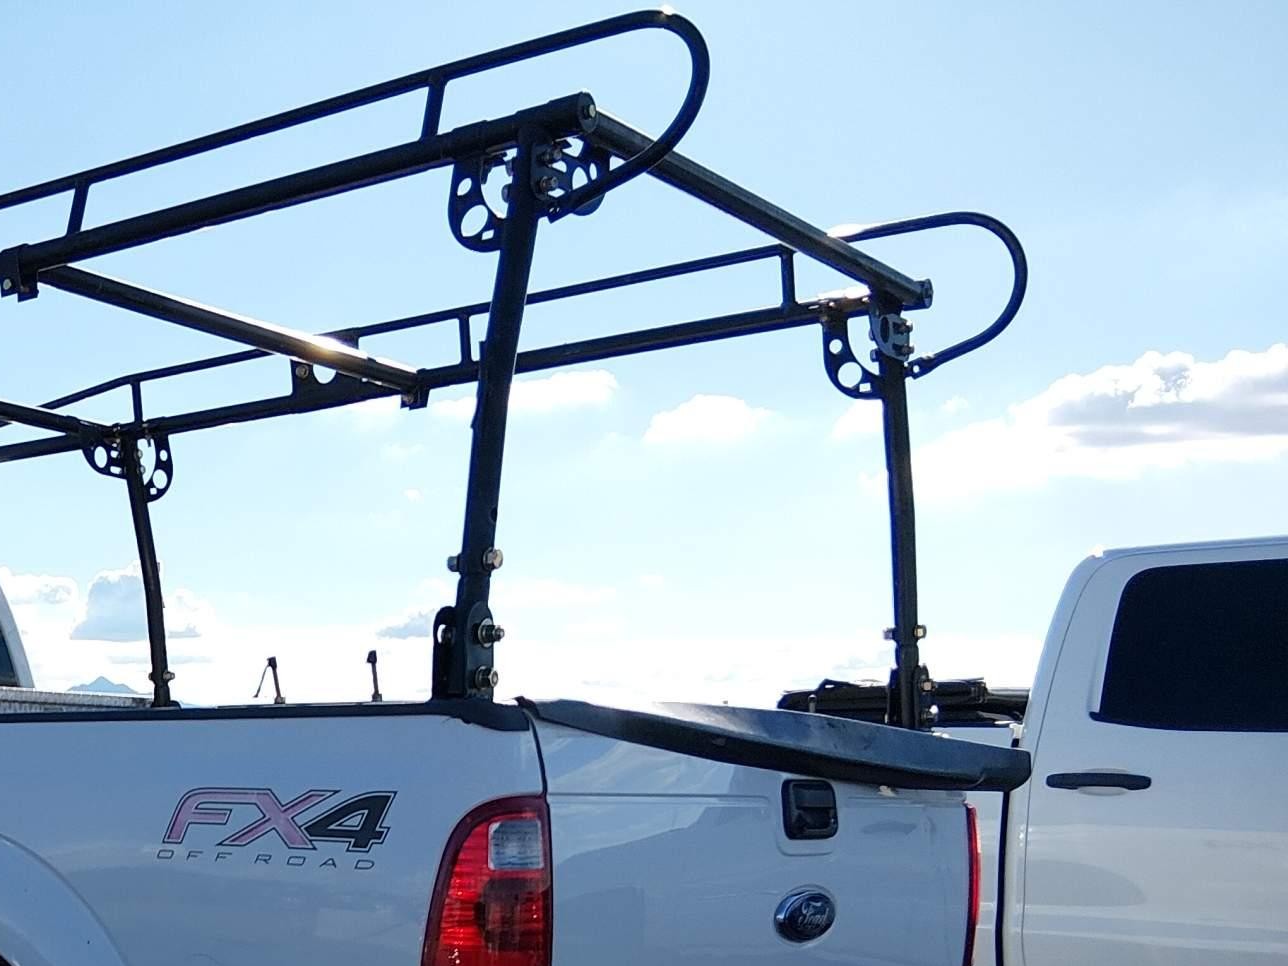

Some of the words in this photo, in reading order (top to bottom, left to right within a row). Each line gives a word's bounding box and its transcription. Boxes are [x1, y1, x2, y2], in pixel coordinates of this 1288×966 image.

[162, 787, 397, 852] FX4
[156, 849, 233, 862] OFF
[253, 854, 376, 870] ROAD
[798, 900, 830, 929] Ford
